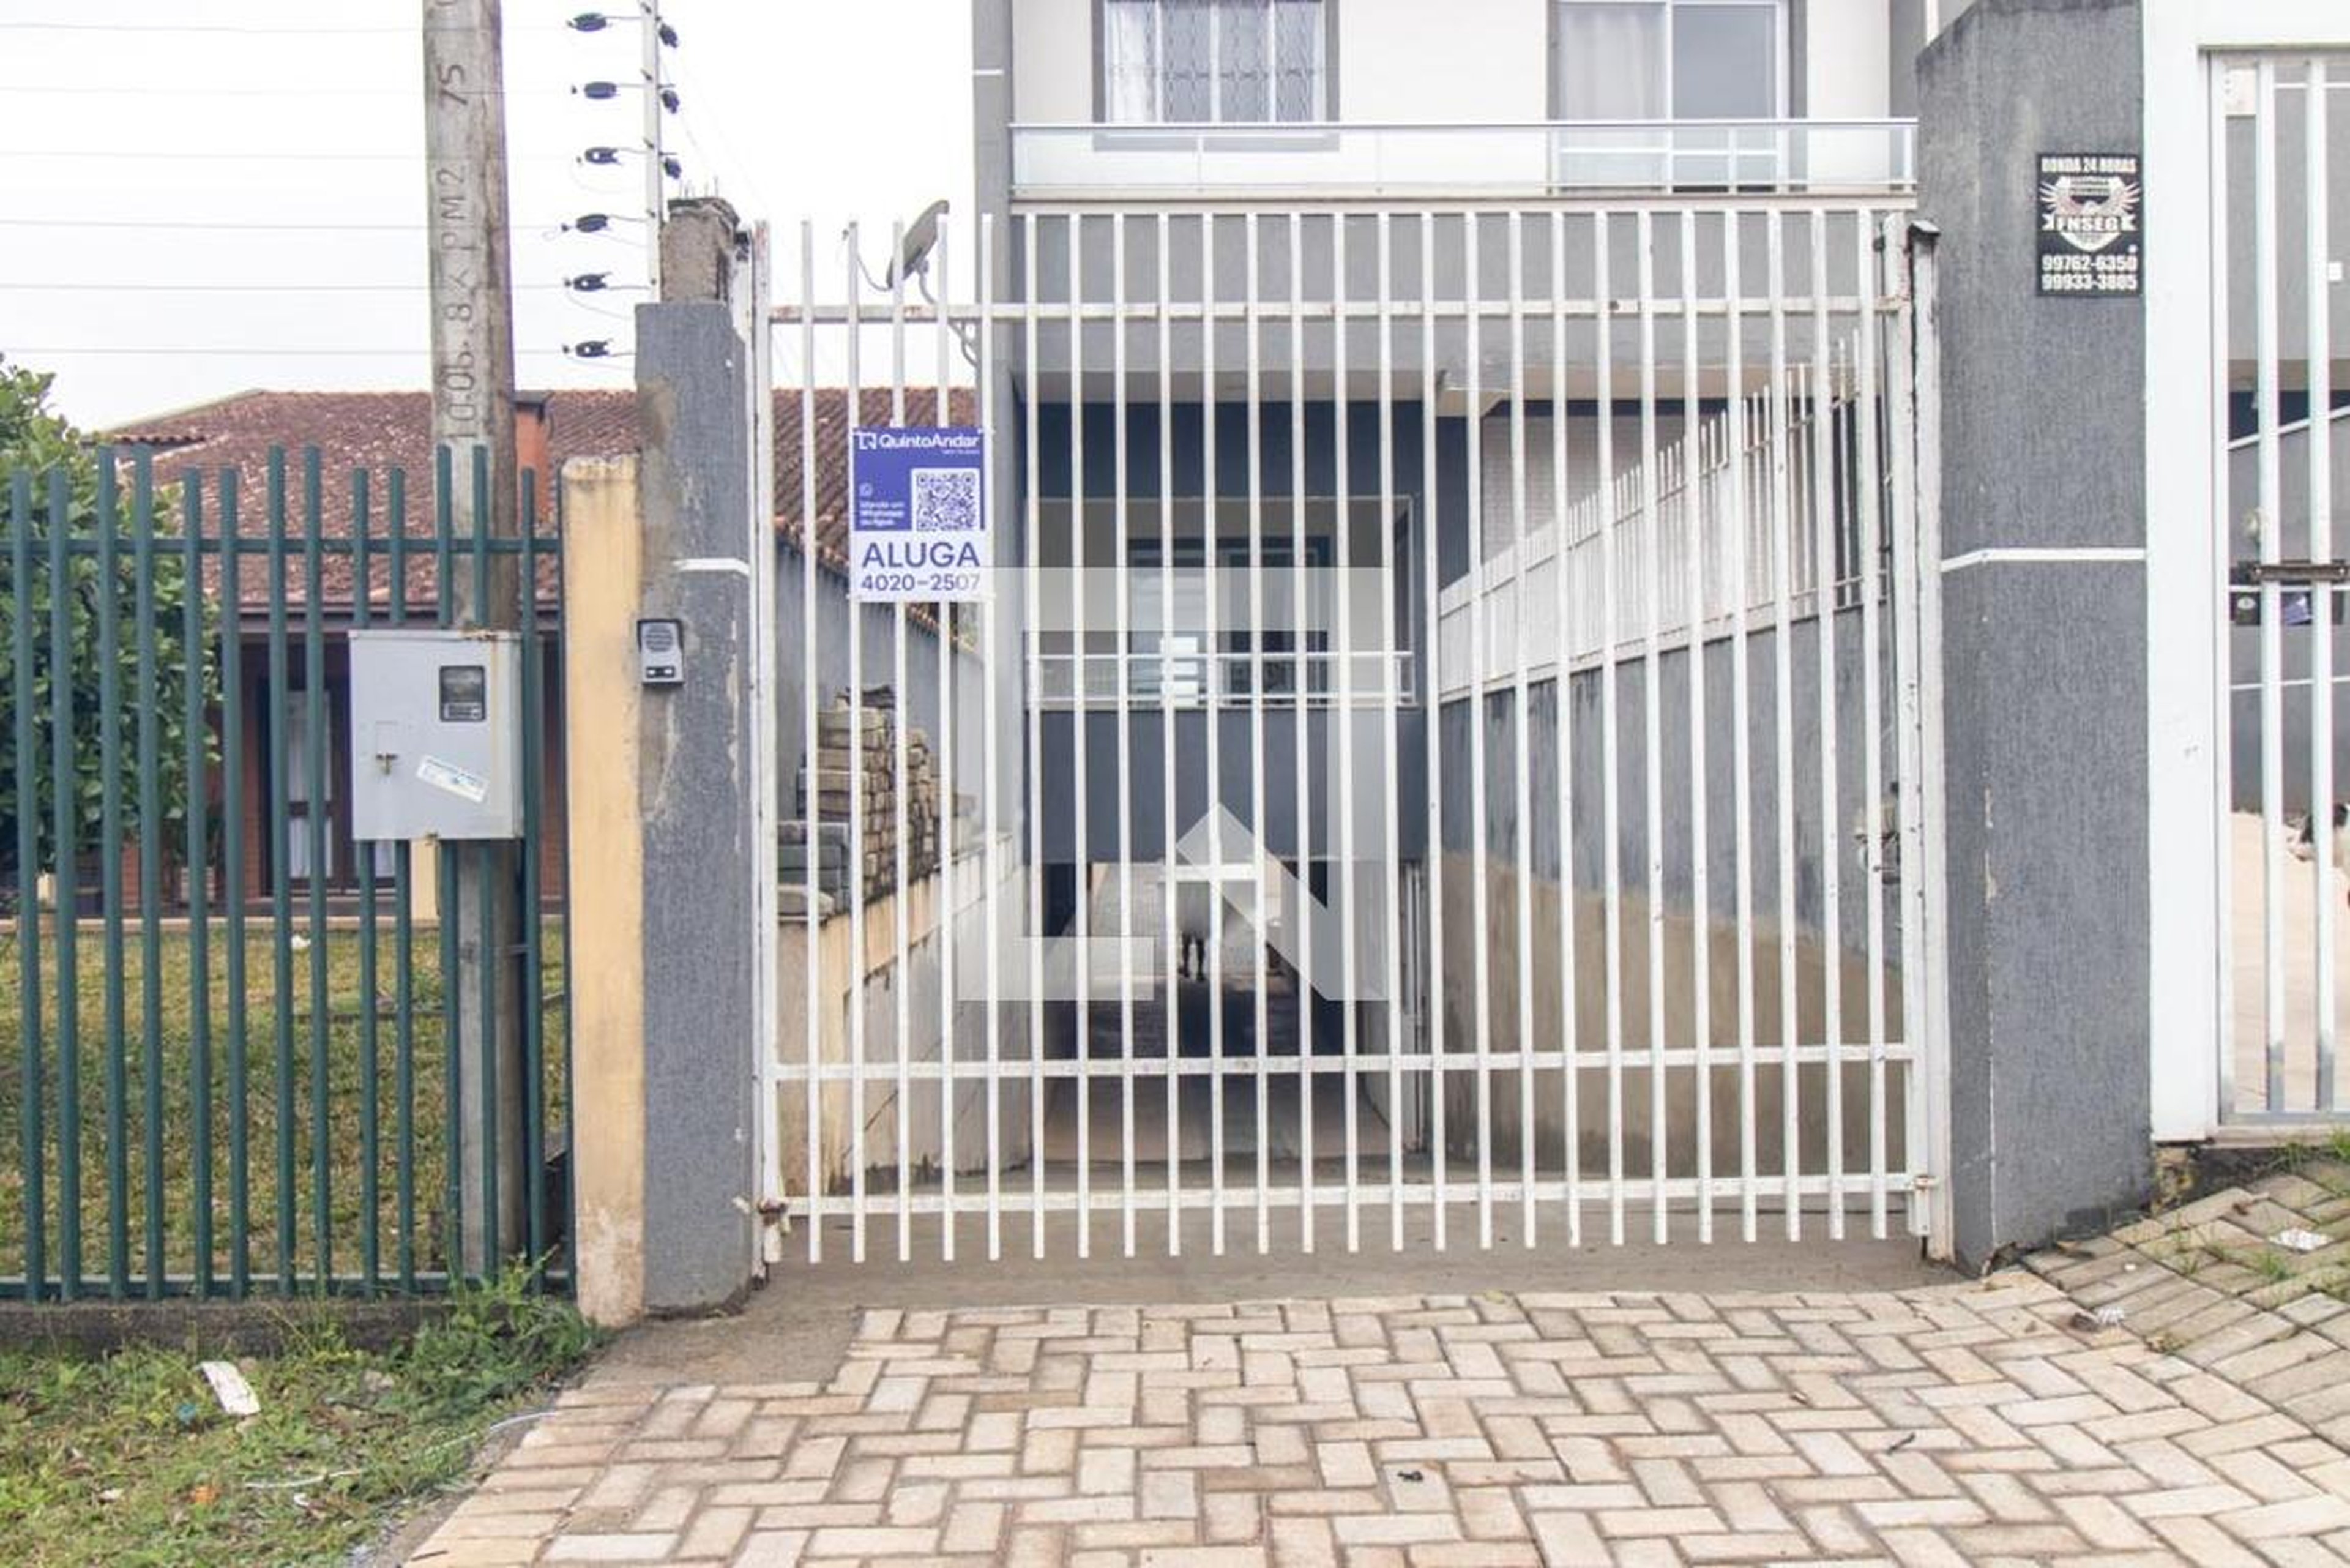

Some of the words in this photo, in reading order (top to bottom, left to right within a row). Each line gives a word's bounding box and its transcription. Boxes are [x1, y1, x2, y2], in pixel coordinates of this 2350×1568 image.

[879, 433, 980, 449] QuintoAndar
[862, 542, 980, 568] ALUGA
[860, 574, 980, 591] 4020-2507
